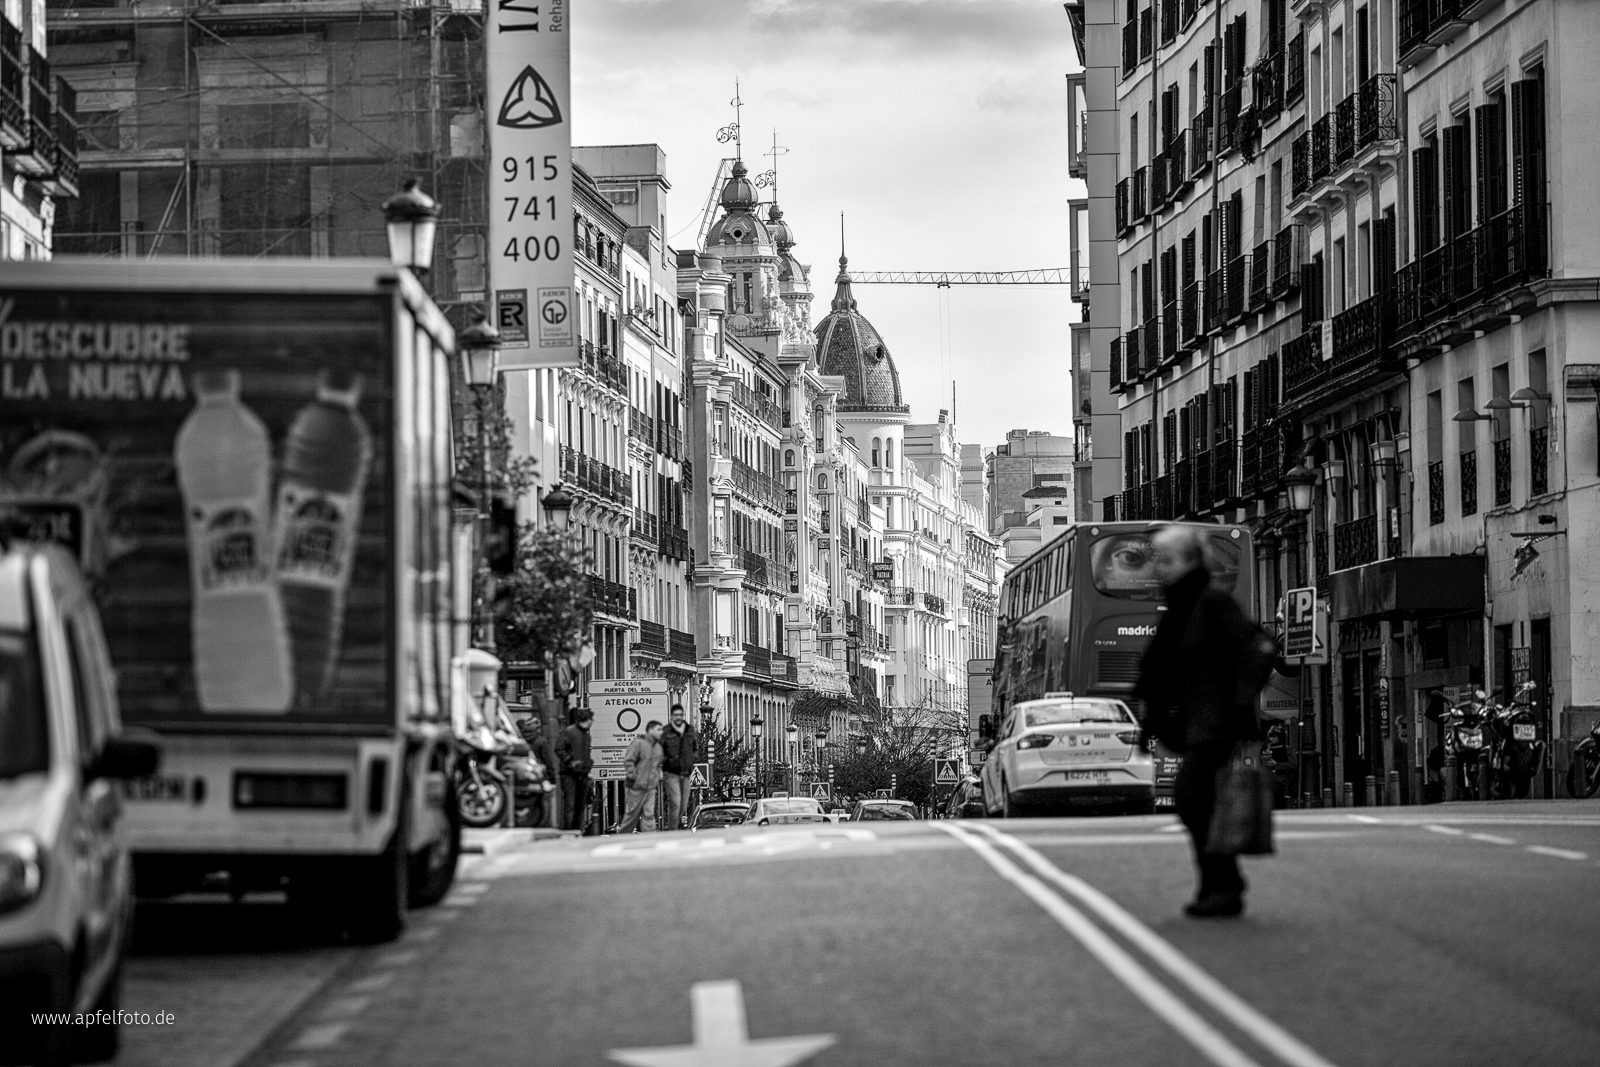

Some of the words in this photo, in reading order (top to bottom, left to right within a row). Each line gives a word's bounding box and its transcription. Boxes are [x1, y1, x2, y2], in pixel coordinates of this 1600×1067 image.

[503, 156, 558, 182] 915
[504, 195, 556, 222] 741
[503, 235, 560, 262] 400
[2, 322, 189, 360] DESCUBRE
[3, 362, 48, 398] LA
[69, 362, 187, 399] NUEVA
[1117, 625, 1157, 636] madrid
